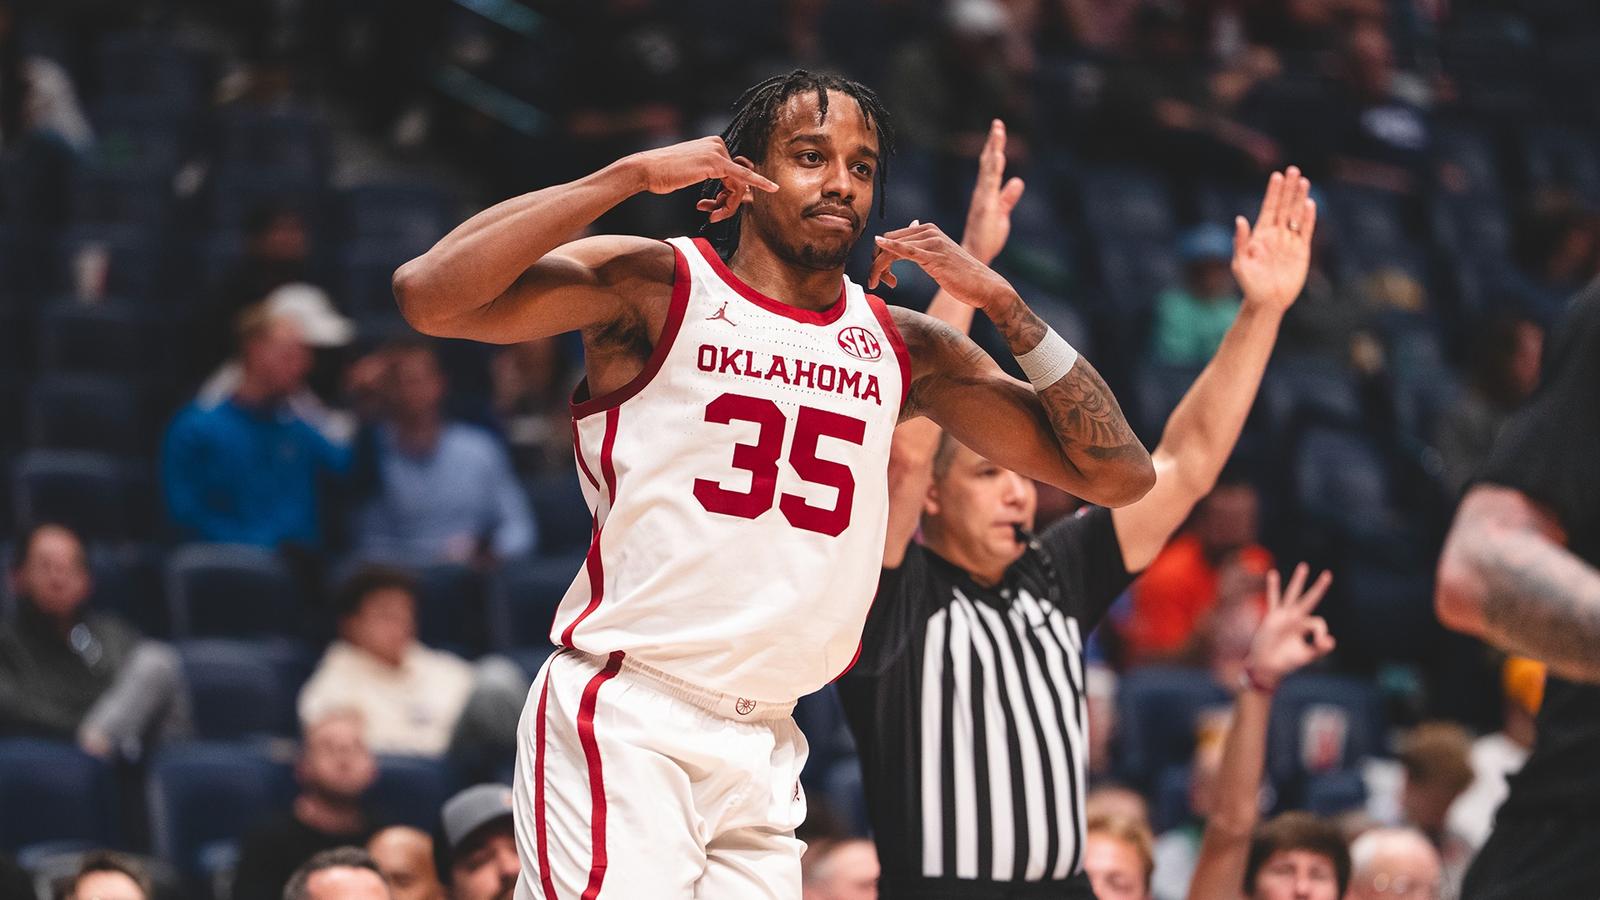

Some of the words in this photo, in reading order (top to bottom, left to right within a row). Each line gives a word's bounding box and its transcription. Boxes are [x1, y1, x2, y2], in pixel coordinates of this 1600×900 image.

[838, 327, 881, 359] SEC
[697, 344, 882, 405] OKLAHOMA
[693, 393, 866, 537] 35
